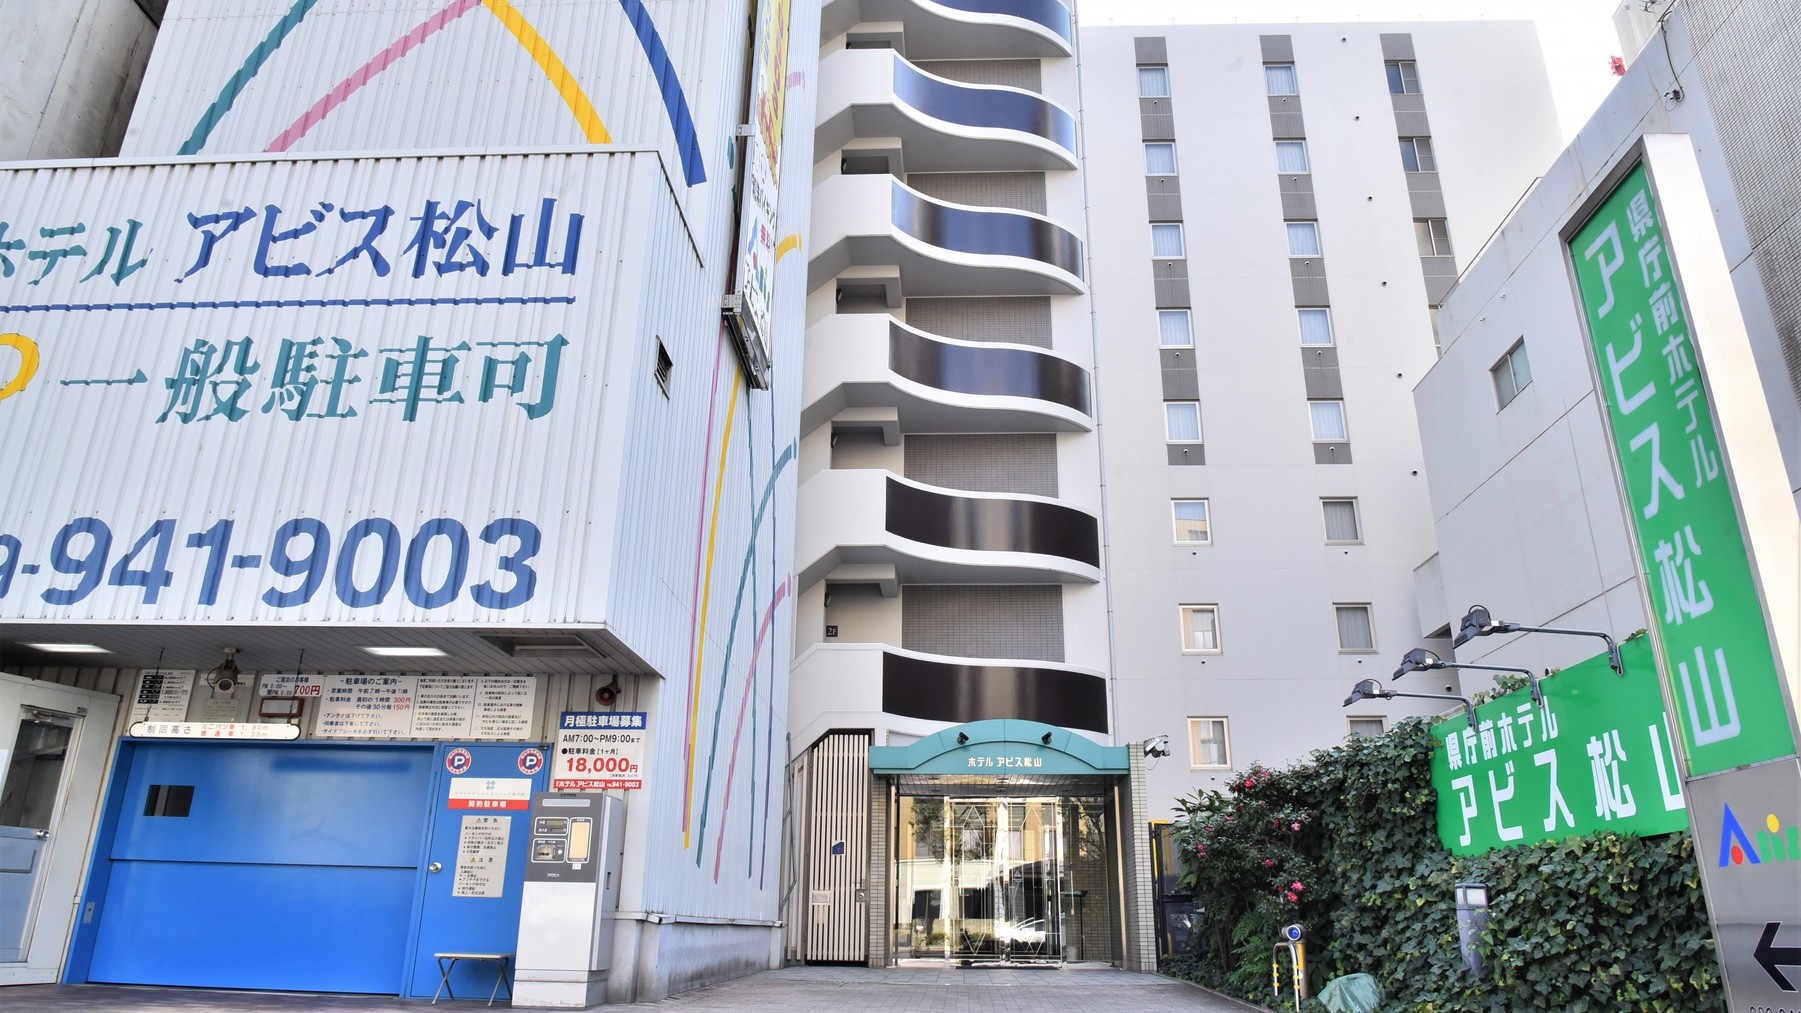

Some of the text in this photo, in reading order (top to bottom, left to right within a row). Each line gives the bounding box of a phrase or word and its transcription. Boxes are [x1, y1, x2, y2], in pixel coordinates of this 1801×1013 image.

[173, 197, 584, 283] アビス松山
[1626, 187, 1719, 489] 県庁前ホテル
[59, 332, 570, 424] 一般駐車可
[1584, 219, 1741, 747] アビス松山
[827, 627, 837, 636] 2F
[345, 677, 397, 686] 駐車場のご案内
[564, 715, 643, 727] 月極駐車場募集
[146, 724, 192, 735] 制限高さ
[1445, 695, 1559, 771] 県庁前ホテル
[566, 756, 639, 774] 18,000円
[968, 756, 1042, 768] ホテル アビス松山
[577, 780, 606, 788] アビス松山
[1451, 711, 1687, 847] アビス松山
[467, 799, 508, 809] 契約駐車場
